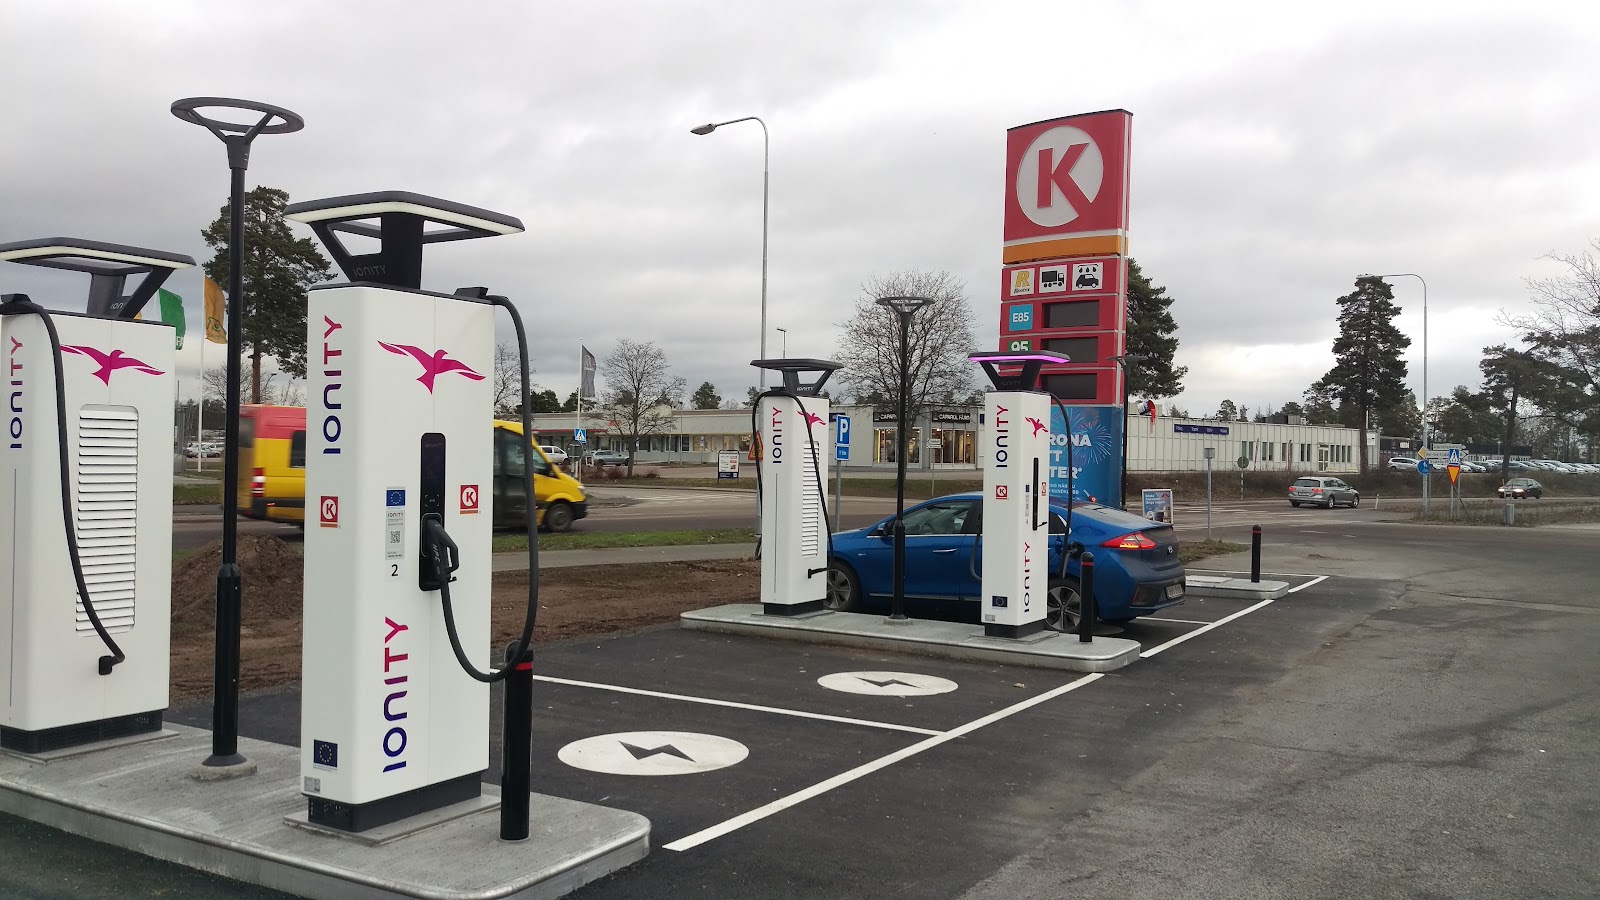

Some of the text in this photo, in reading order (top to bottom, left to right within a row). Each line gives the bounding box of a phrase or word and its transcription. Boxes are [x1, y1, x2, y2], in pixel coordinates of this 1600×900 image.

[353, 265, 386, 277] IONITY
[1012, 312, 1030, 323] E85
[1011, 341, 1029, 351] 95
[10, 335, 23, 448] IONITY
[323, 315, 342, 454] IONITY
[772, 406, 782, 464] IONITY
[840, 418, 849, 442] P
[996, 404, 1009, 468] IONITY
[1050, 433, 1092, 447] RONA
[1050, 466, 1083, 479] TER
[391, 563, 399, 577] 2
[382, 616, 409, 773] IONITY
